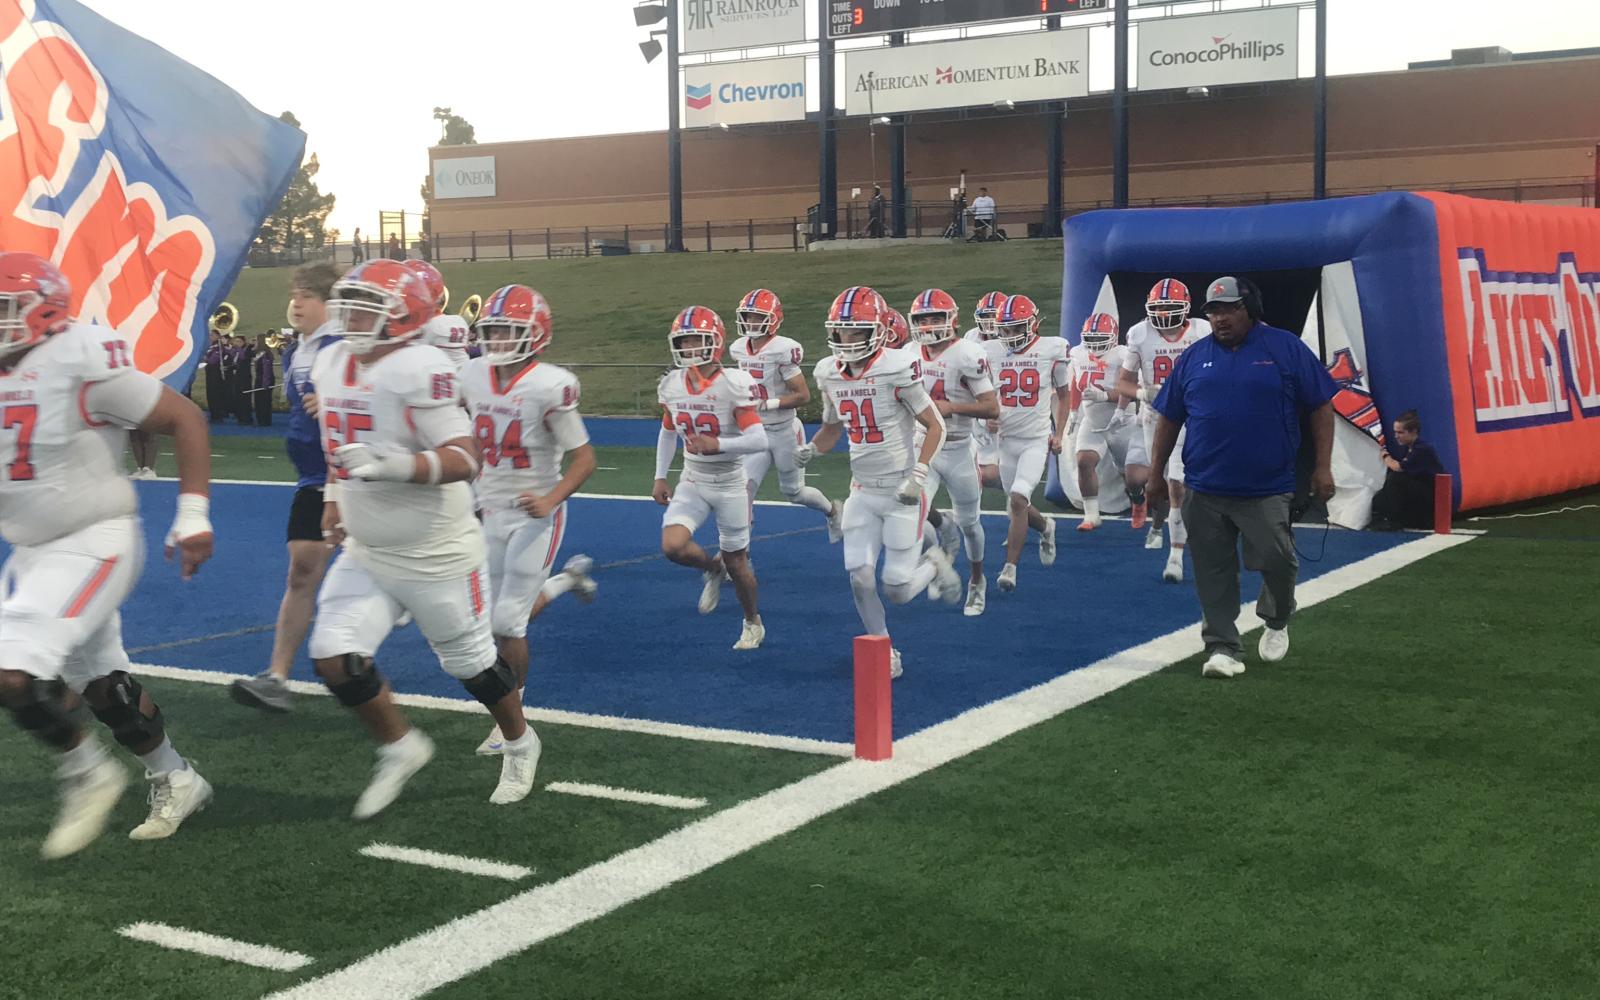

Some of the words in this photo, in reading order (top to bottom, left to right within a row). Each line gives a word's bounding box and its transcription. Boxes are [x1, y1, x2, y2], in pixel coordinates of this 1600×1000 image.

[832, 12, 852, 23] OUTS
[854, 8, 864, 25] 3
[833, 2, 850, 12] TIME
[833, 23, 851, 34] LEFT
[1150, 41, 1285, 66] ConocoPhillips
[854, 73, 929, 92] AMERICAN
[936, 65, 1029, 85] MOMENTUM
[1034, 58, 1080, 77] BANK
[719, 82, 804, 104] Chevron
[1001, 360, 1014, 368] SAN
[1014, 360, 1038, 368] ANGELO
[836, 389, 849, 398] SAN
[850, 388, 876, 398] ANGELO
[998, 368, 1040, 407] 29
[839, 398, 884, 444] 31
[475, 414, 531, 469] 94
